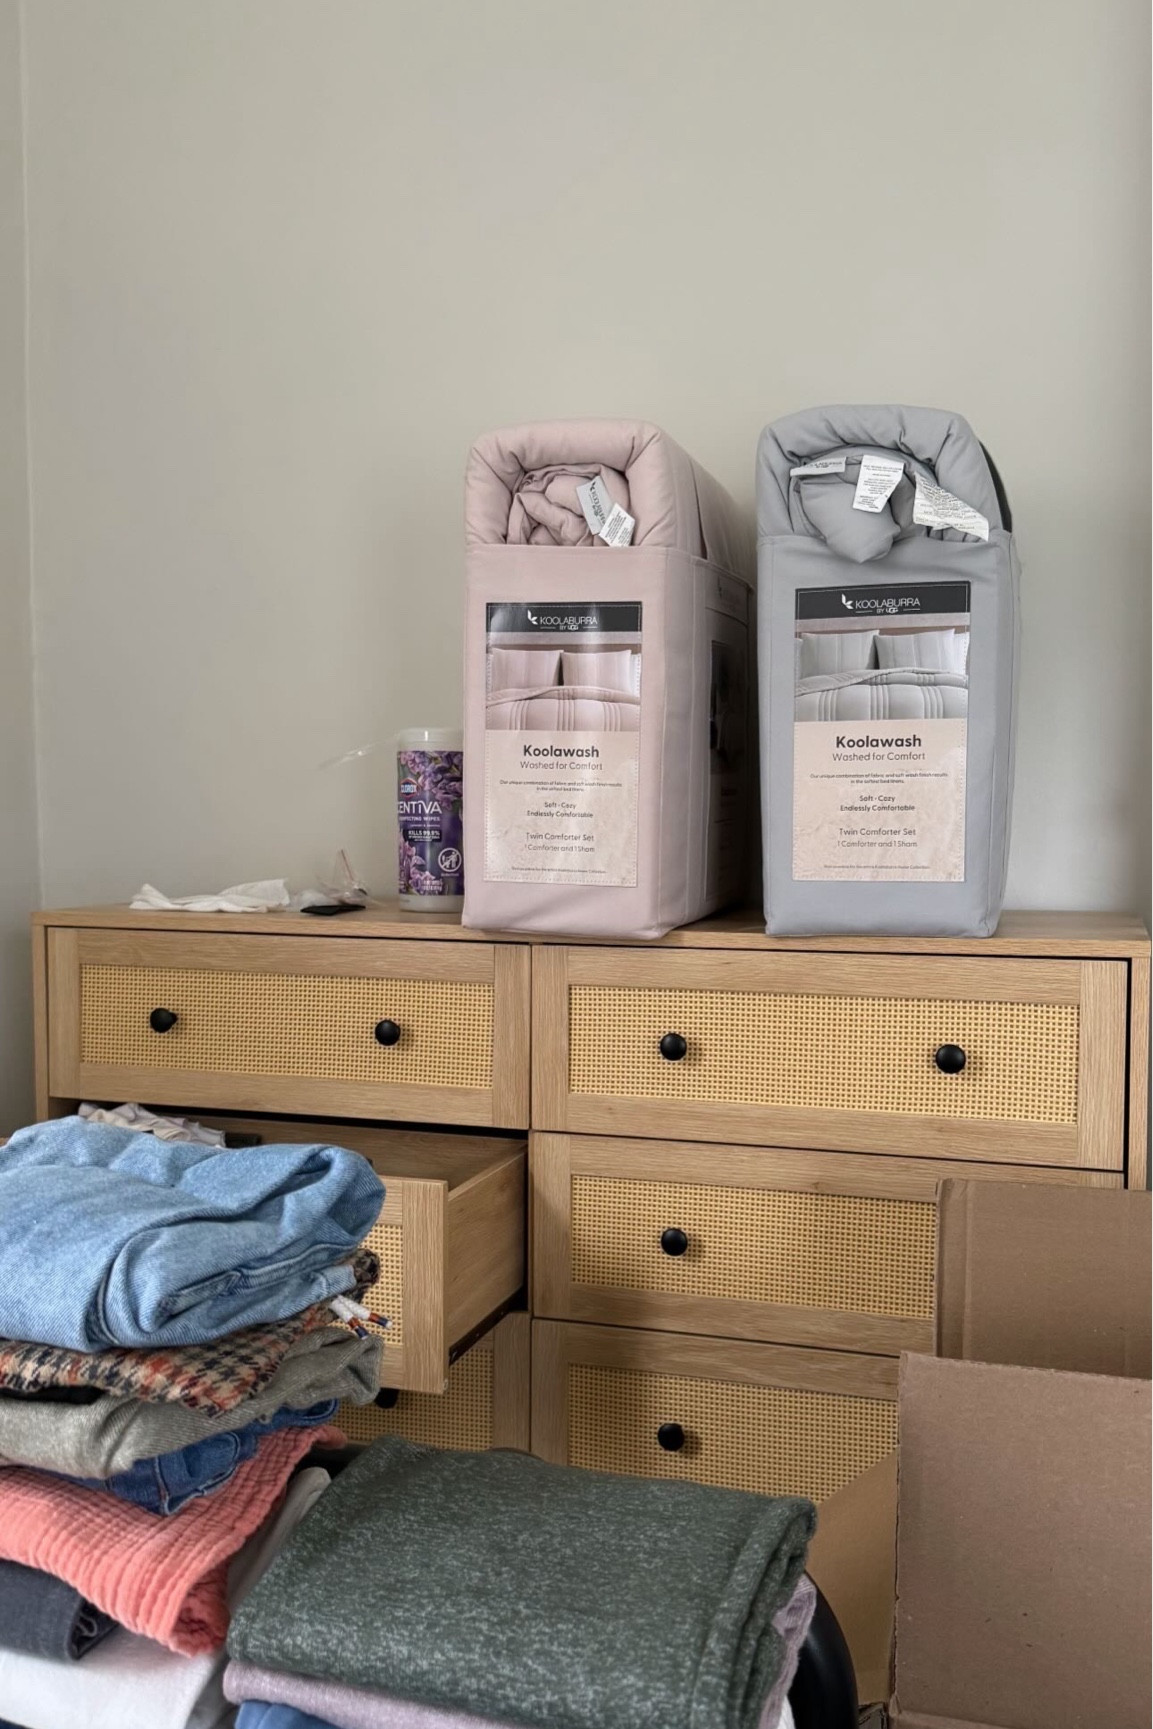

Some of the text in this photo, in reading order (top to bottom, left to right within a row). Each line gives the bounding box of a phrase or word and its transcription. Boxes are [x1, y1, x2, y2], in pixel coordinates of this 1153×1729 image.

[855, 597, 920, 609] KOOLABURRA
[540, 616, 598, 625] KOOLABURRA
[836, 734, 922, 748] Koolawash
[523, 744, 600, 758] Koolawash
[832, 752, 925, 762] Washed for Comfort
[520, 761, 603, 771] Washed for Comfort
[526, 832, 594, 842] Twin Comforter Set
[840, 828, 858, 836] Twin
[860, 828, 901, 836] Comforter
